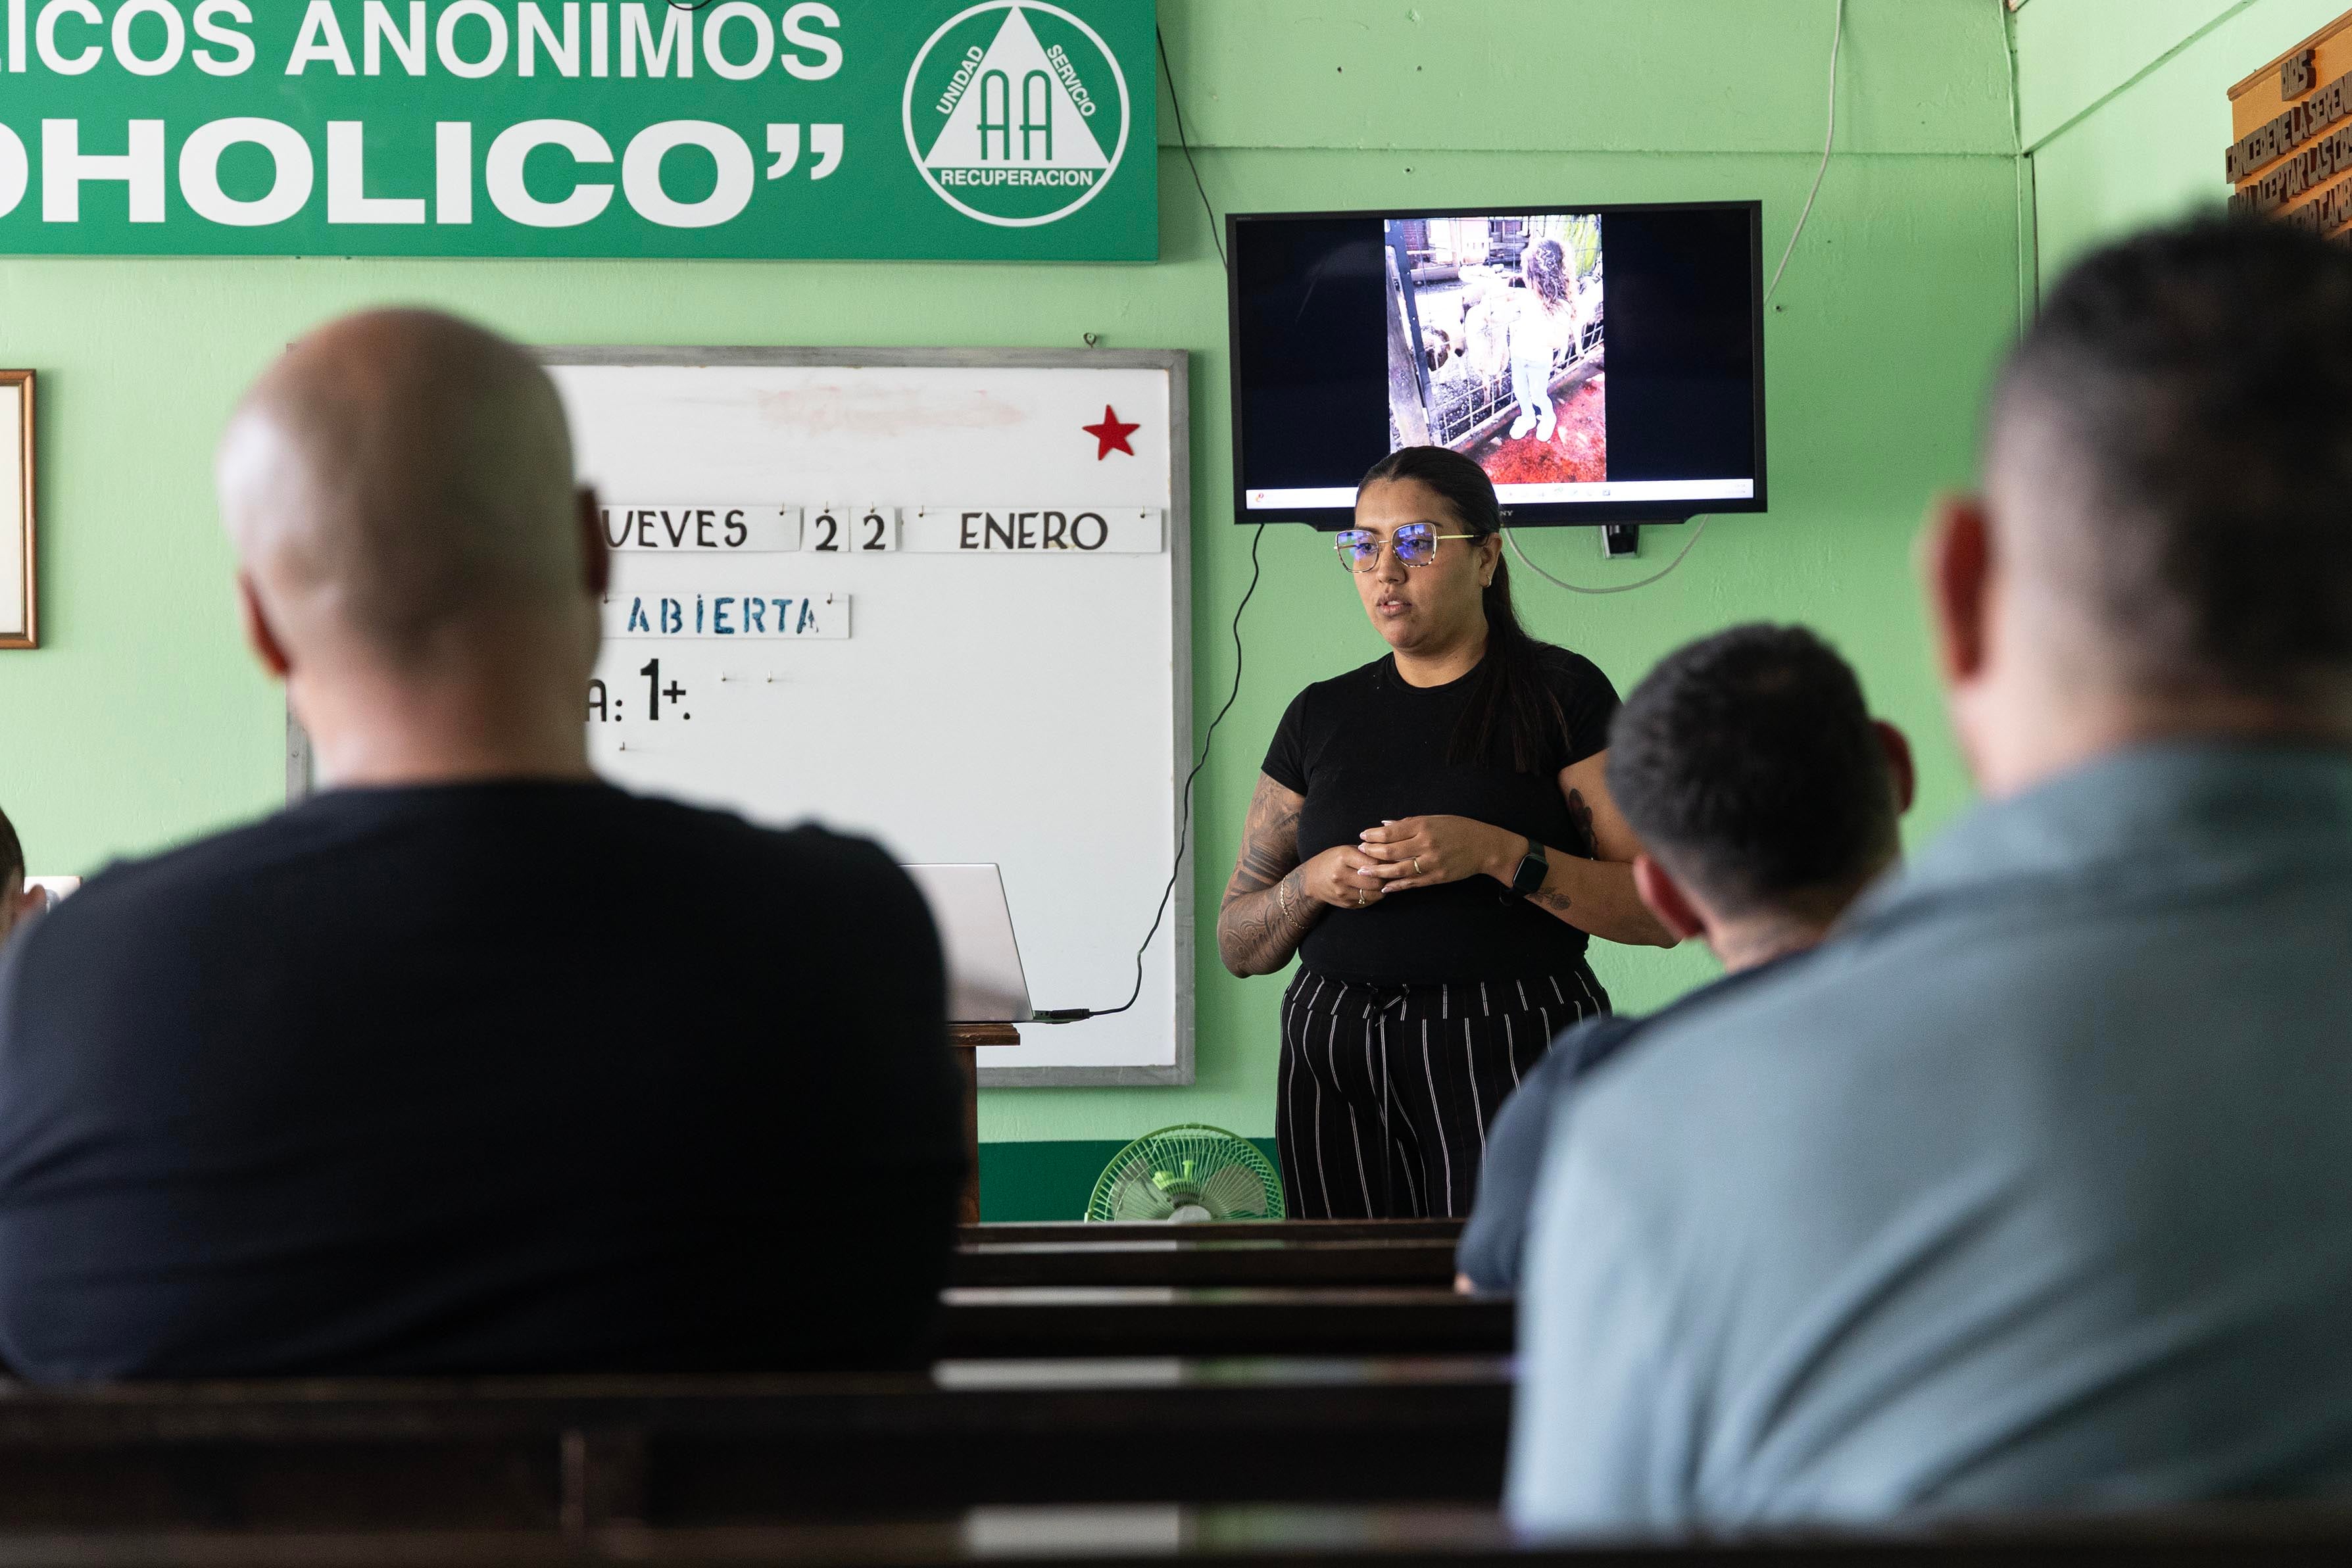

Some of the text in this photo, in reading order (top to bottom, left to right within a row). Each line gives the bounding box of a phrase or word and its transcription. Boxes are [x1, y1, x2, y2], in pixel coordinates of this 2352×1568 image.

[0, 0, 844, 80] ICOS ANONIMOS
[935, 45, 984, 114] UNIDAD
[977, 69, 1052, 160] AA
[1046, 44, 1096, 116] SERVICIO
[0, 117, 844, 228] HOLICO”
[941, 169, 1094, 186] RECUPERACION
[601, 509, 748, 549] UEVES
[960, 511, 1108, 551] ENERO
